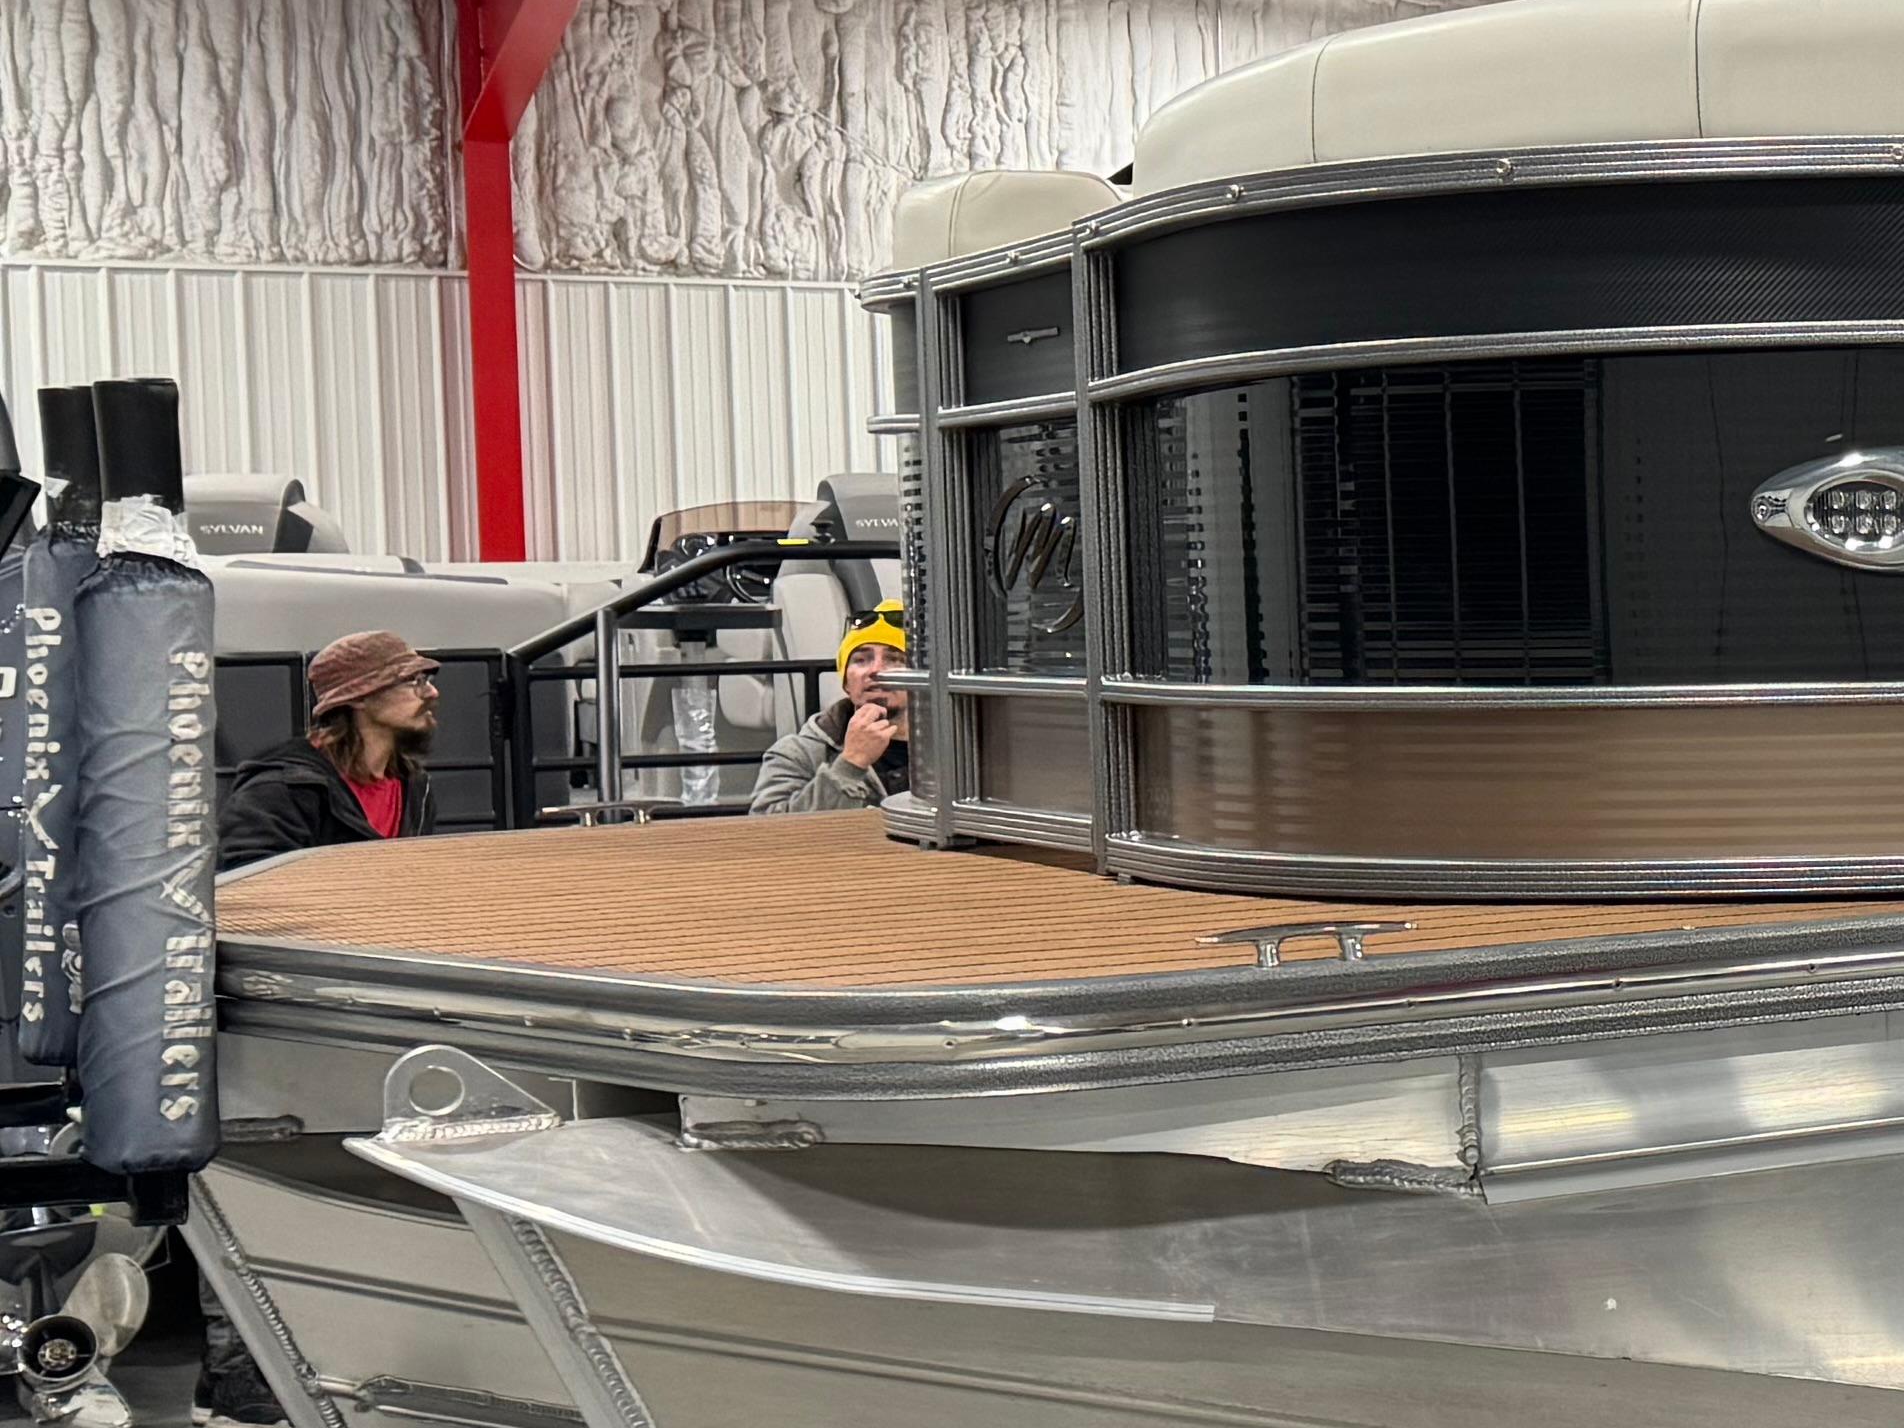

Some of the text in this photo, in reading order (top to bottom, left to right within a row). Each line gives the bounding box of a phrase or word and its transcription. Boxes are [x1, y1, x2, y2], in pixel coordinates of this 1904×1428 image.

[200, 523, 264, 536] SYLVAN
[854, 517, 900, 529] SYLVA
[167, 650, 211, 850] Phoenix
[21, 606, 63, 1023] Phoenix Trailers
